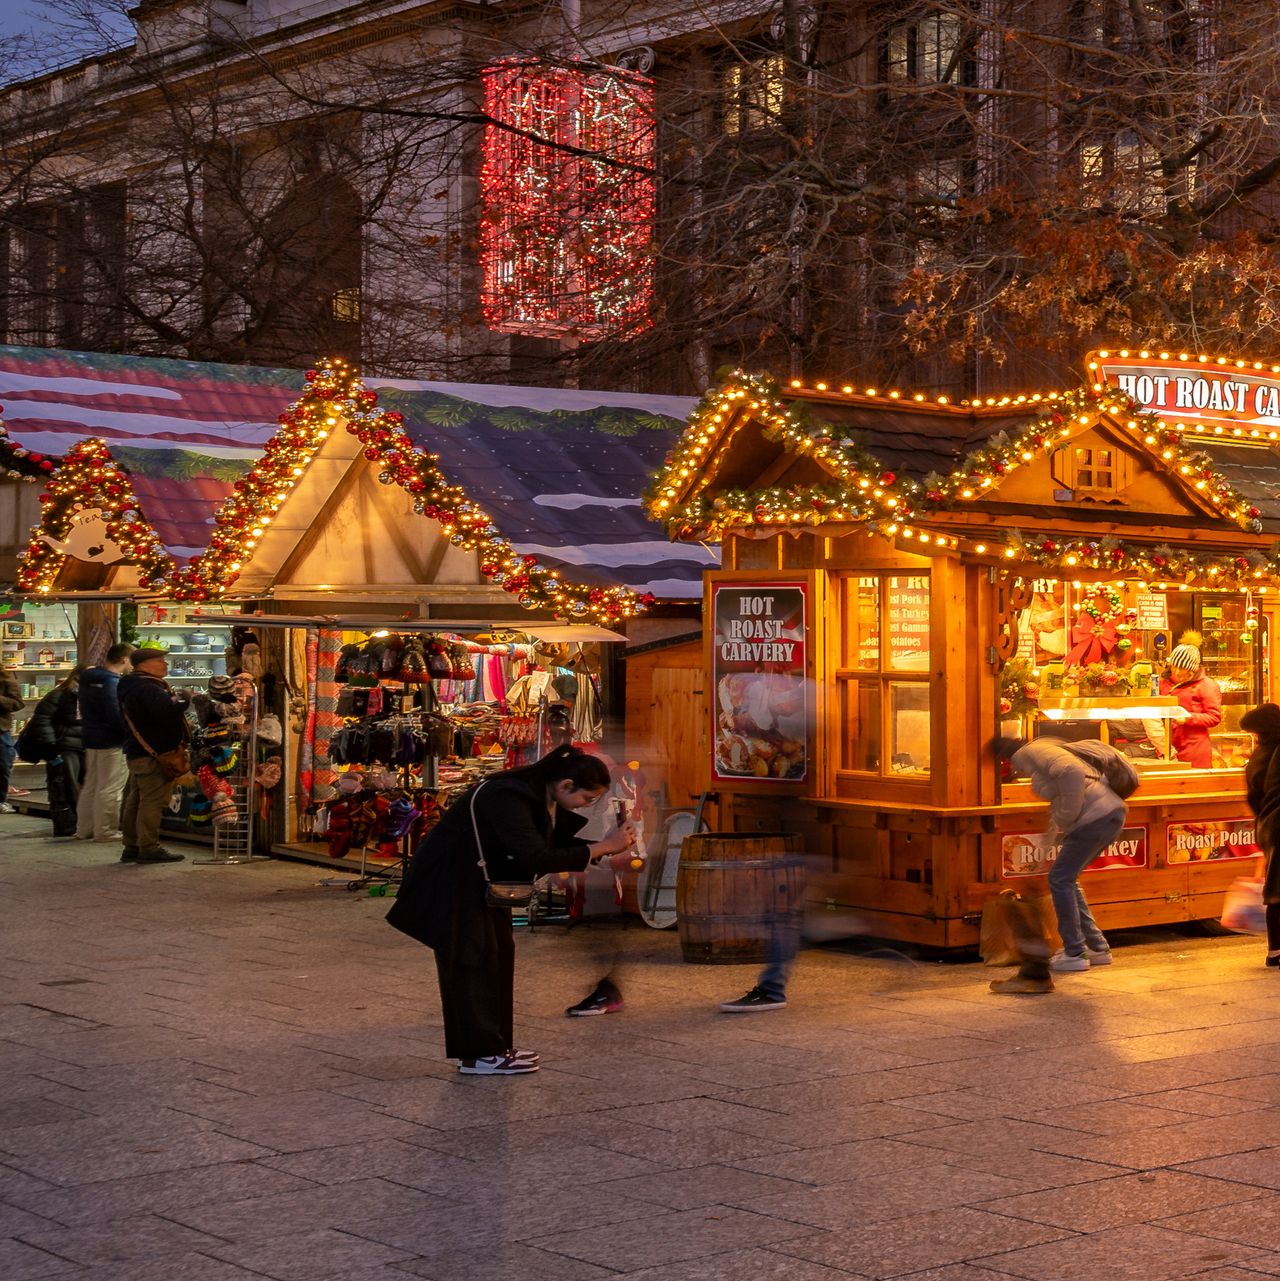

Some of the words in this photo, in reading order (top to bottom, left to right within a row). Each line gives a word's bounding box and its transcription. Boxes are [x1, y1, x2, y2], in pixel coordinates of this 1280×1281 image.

[1117, 374, 1169, 406] HOT
[1175, 376, 1249, 413] ROAST
[80, 513, 100, 525] Tea
[739, 596, 775, 616] HOT
[901, 594, 922, 605] Pork
[730, 619, 784, 639] ROAST
[892, 636, 921, 647] otatoes
[721, 643, 795, 662] CARVERY
[1176, 831, 1216, 851] Roast
[1219, 828, 1256, 848] Potat
[1020, 844, 1064, 865] Roas
